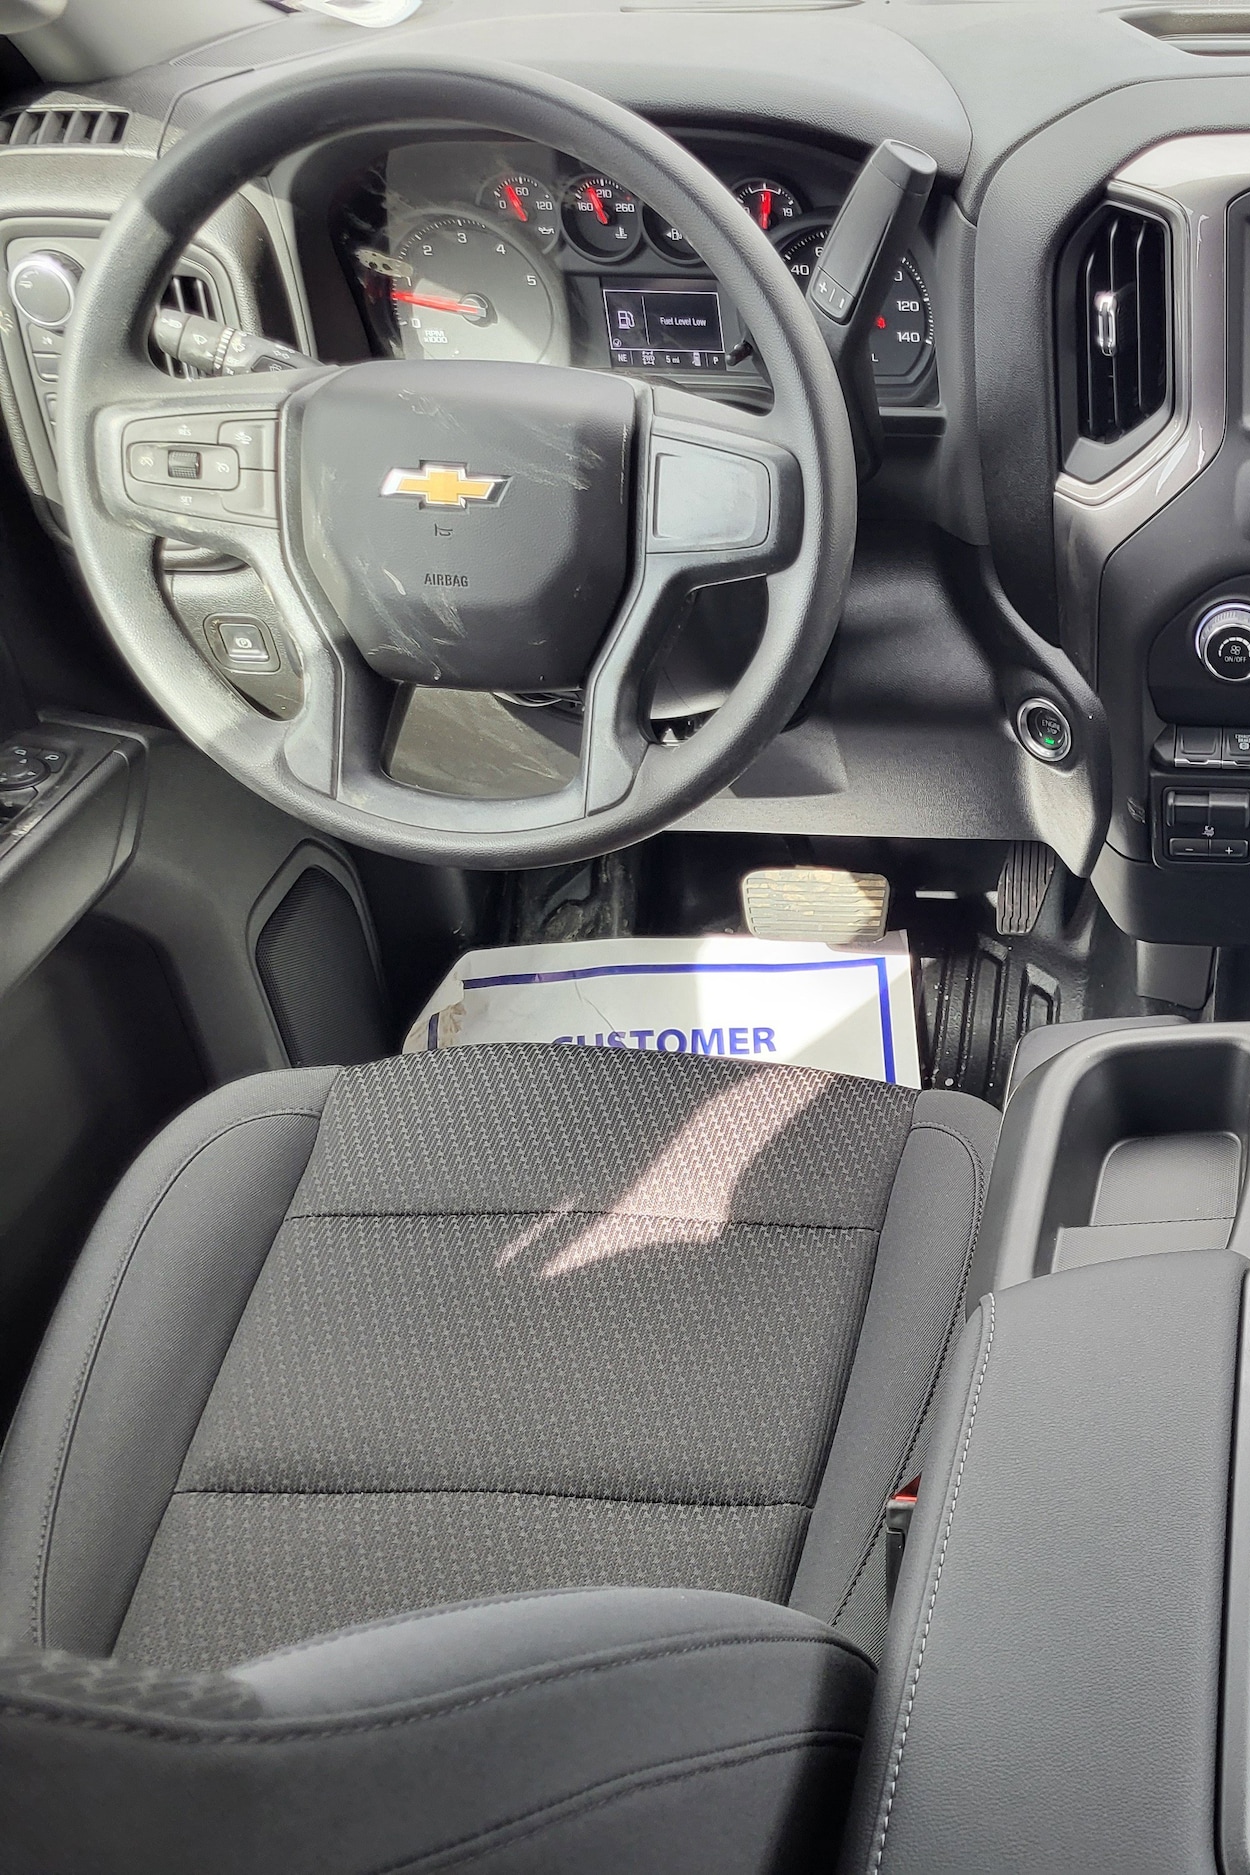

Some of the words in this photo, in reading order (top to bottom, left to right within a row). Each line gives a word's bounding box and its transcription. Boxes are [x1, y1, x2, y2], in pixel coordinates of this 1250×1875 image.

[516, 187, 529, 196] 60
[596, 189, 612, 198] 210
[536, 201, 553, 210] 120
[577, 202, 593, 212] 160
[615, 203, 635, 213] 260
[782, 207, 793, 217] 19
[457, 233, 467, 243] 3
[422, 245, 433, 256] 2
[496, 244, 506, 255] 4
[791, 265, 809, 276] 40
[526, 275, 537, 286] 5
[896, 301, 920, 312] 120
[660, 317, 673, 326] Fuel
[674, 317, 691, 326] Level
[692, 318, 707, 327] Low
[897, 332, 920, 343] 140
[618, 354, 628, 362] NE
[424, 573, 469, 587] AIRBAG
